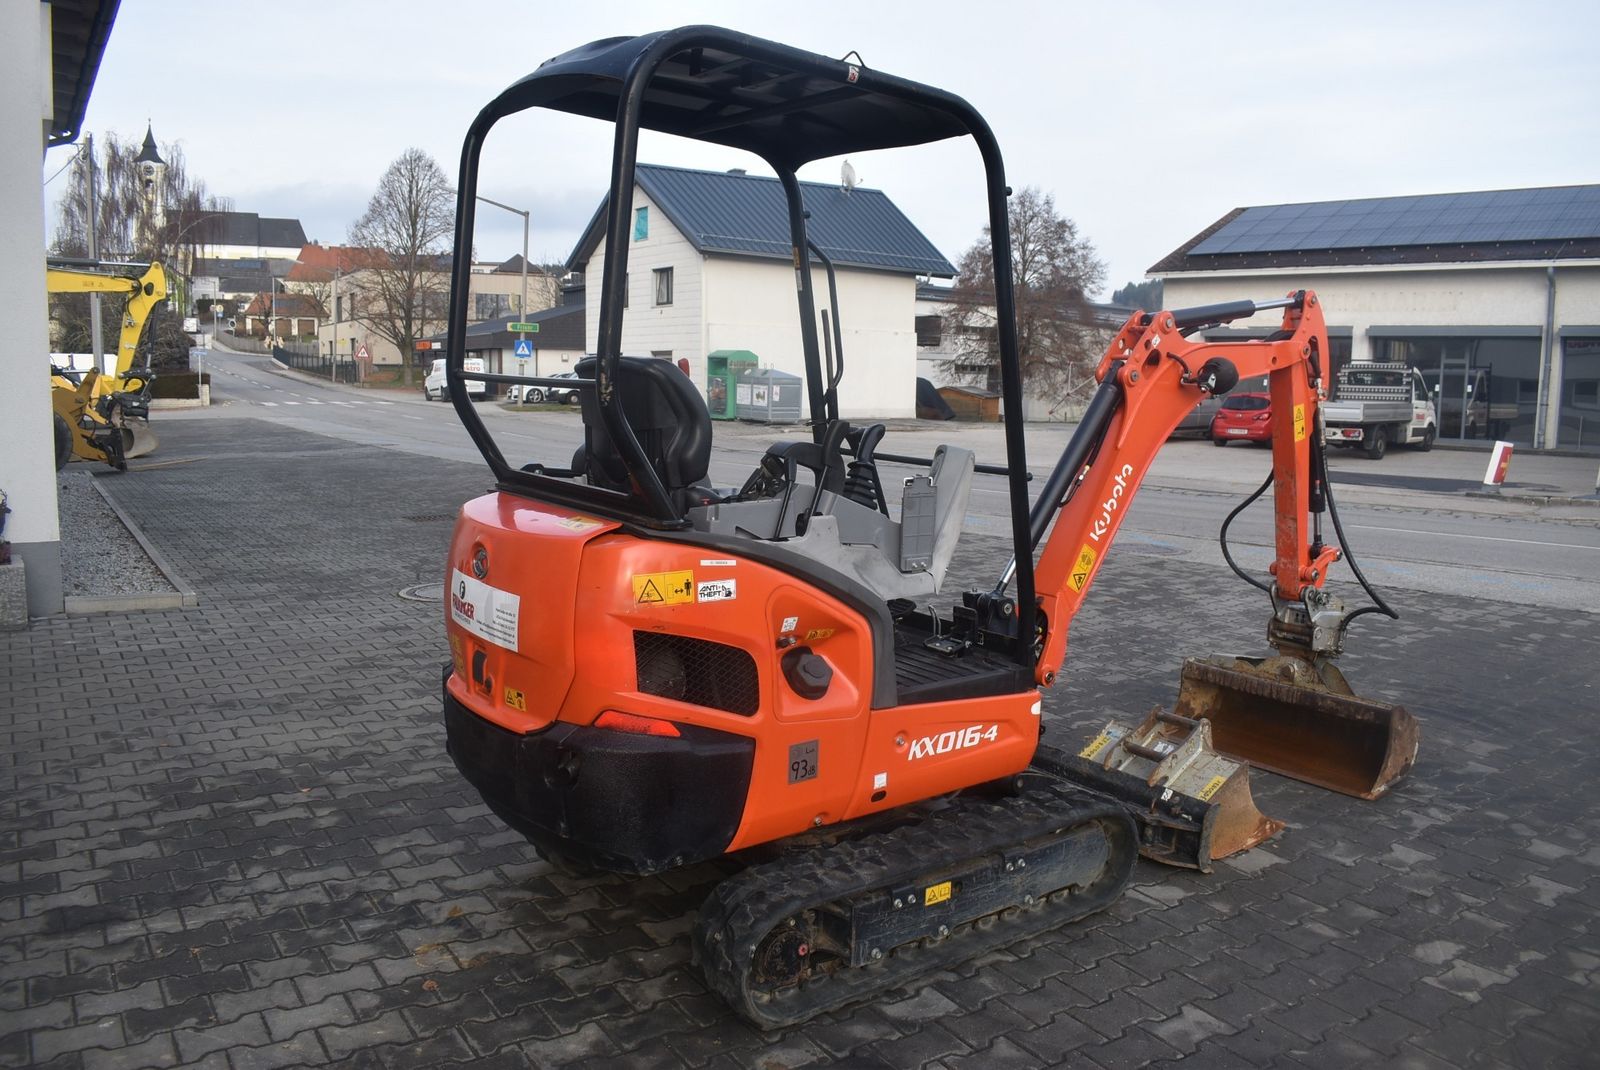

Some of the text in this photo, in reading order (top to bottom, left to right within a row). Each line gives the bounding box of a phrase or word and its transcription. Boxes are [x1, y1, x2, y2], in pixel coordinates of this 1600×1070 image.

[1089, 463, 1134, 542] Kubota
[699, 590, 722, 598] THEFT
[791, 759, 808, 780] 93
